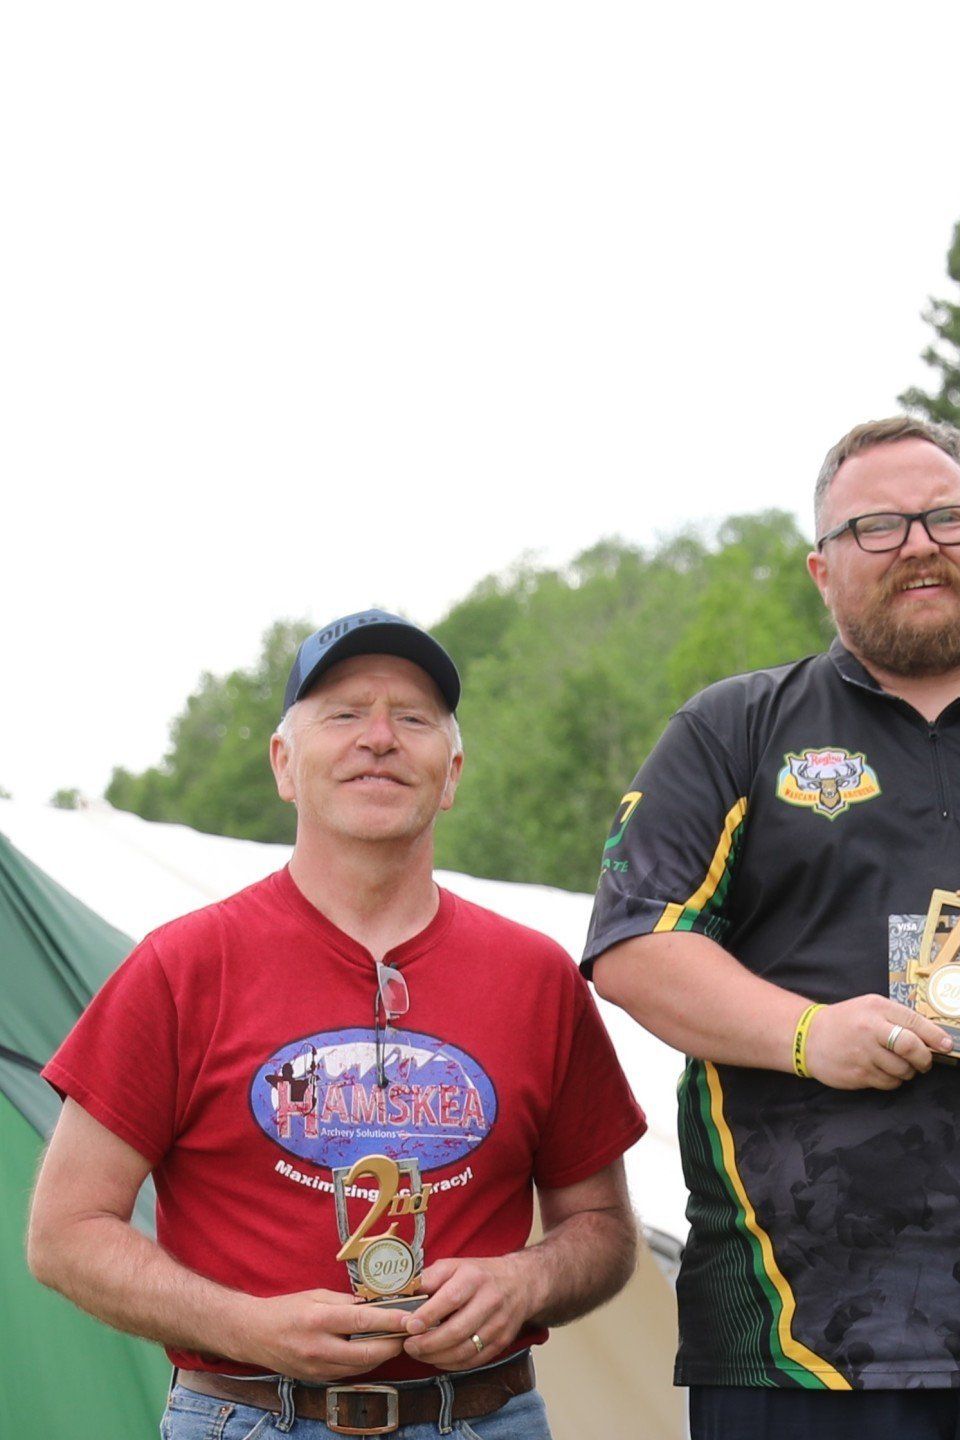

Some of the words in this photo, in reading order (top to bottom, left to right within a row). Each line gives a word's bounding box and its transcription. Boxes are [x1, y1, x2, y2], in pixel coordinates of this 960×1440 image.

[897, 923, 918, 932] VISA
[273, 1080, 488, 1140] HAMSKEA
[320, 1127, 355, 1140] Archery
[356, 1127, 397, 1139] Solutions
[274, 1159, 380, 1203] Maximzing
[373, 1258, 410, 1277] 2019
